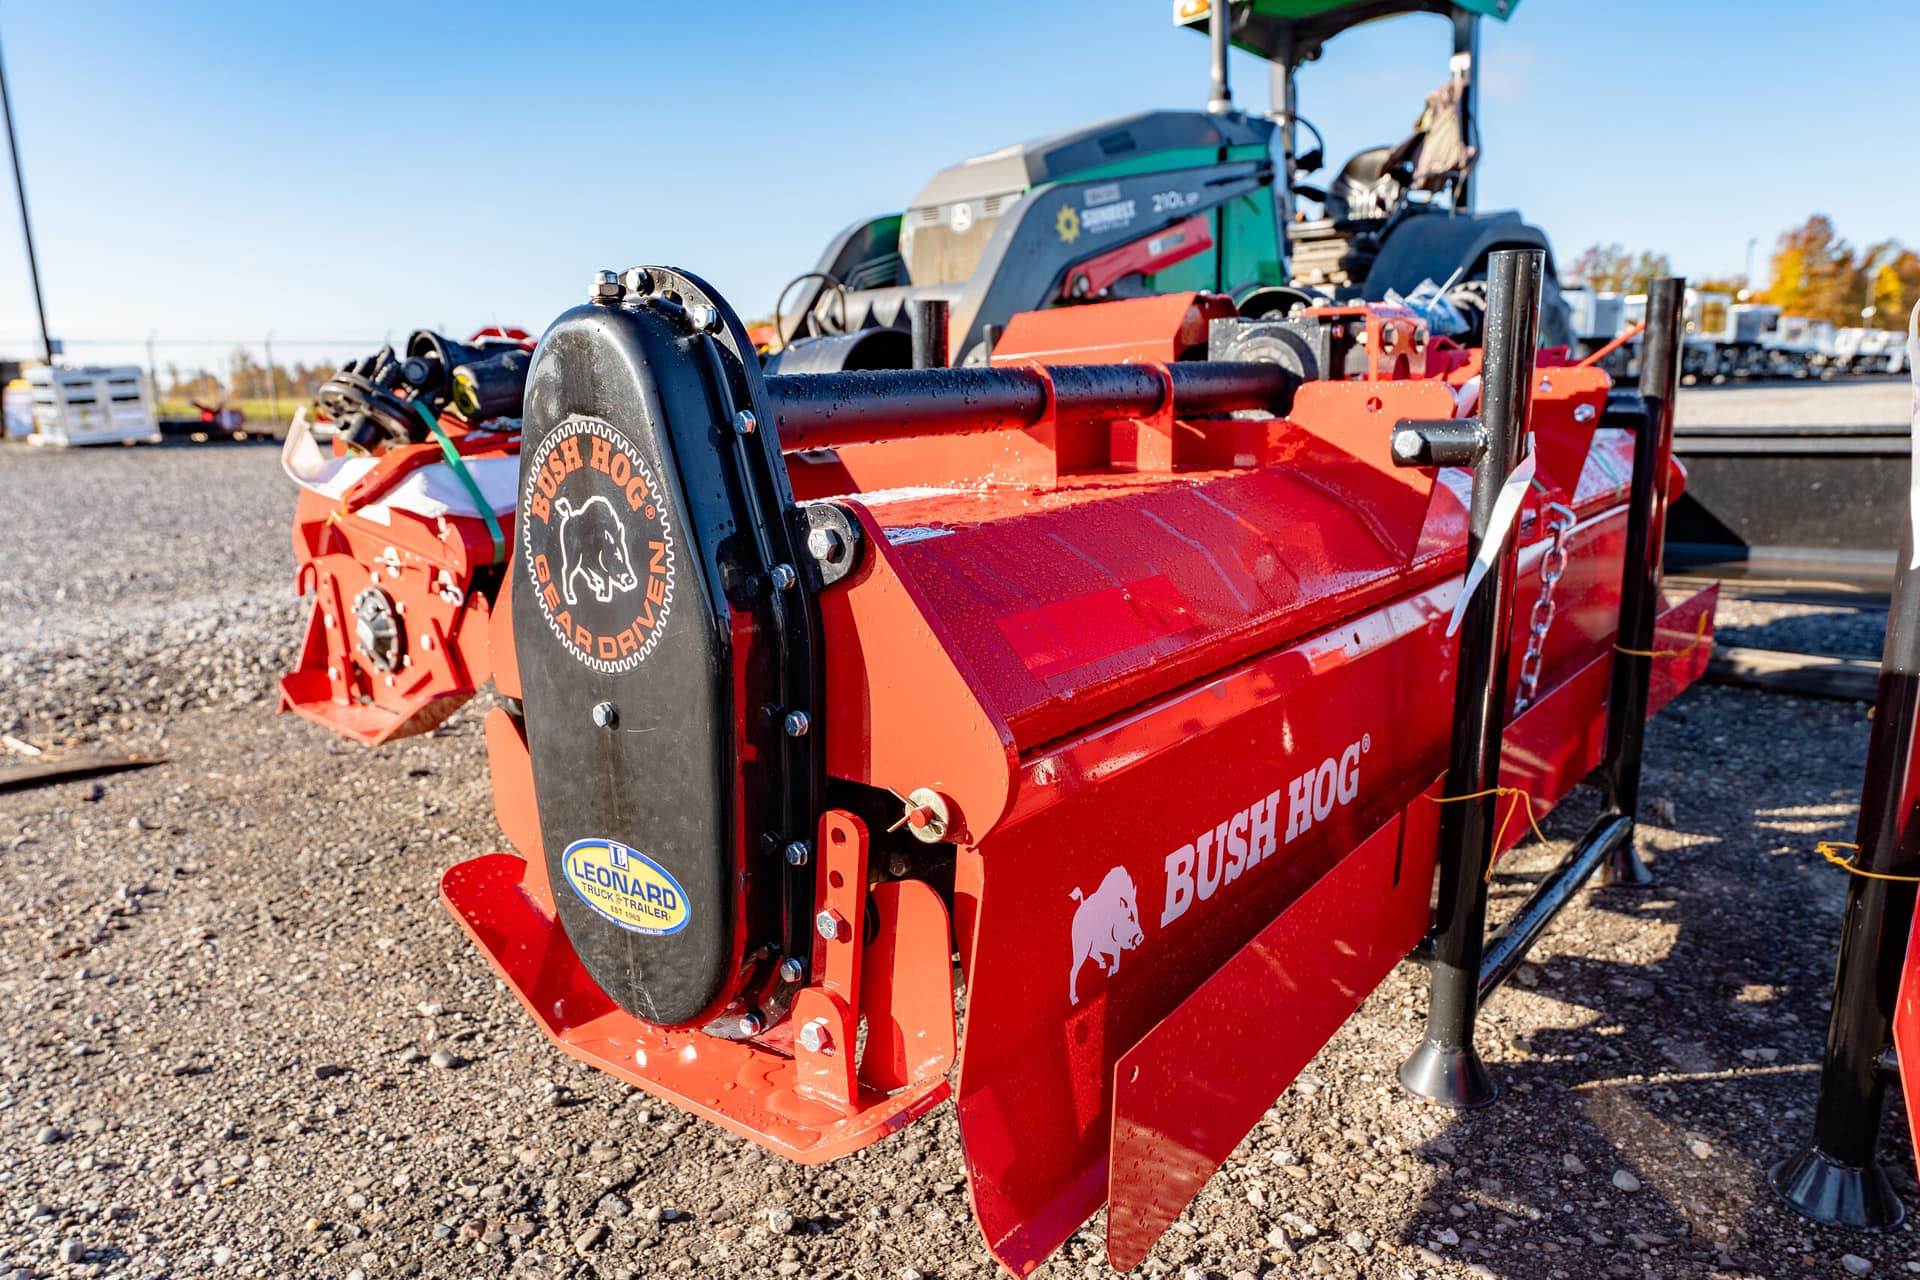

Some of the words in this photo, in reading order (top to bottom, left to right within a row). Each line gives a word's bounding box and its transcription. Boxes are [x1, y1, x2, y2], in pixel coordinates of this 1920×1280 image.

[531, 436, 584, 525] BUSH
[534, 553, 593, 655] GEAR
[599, 541, 667, 660] DRIVEN
[573, 857, 677, 911] LEONARD
[581, 881, 614, 902] TRUCK
[622, 896, 668, 921] TRAILER
[1160, 789, 1280, 928] BUSH
